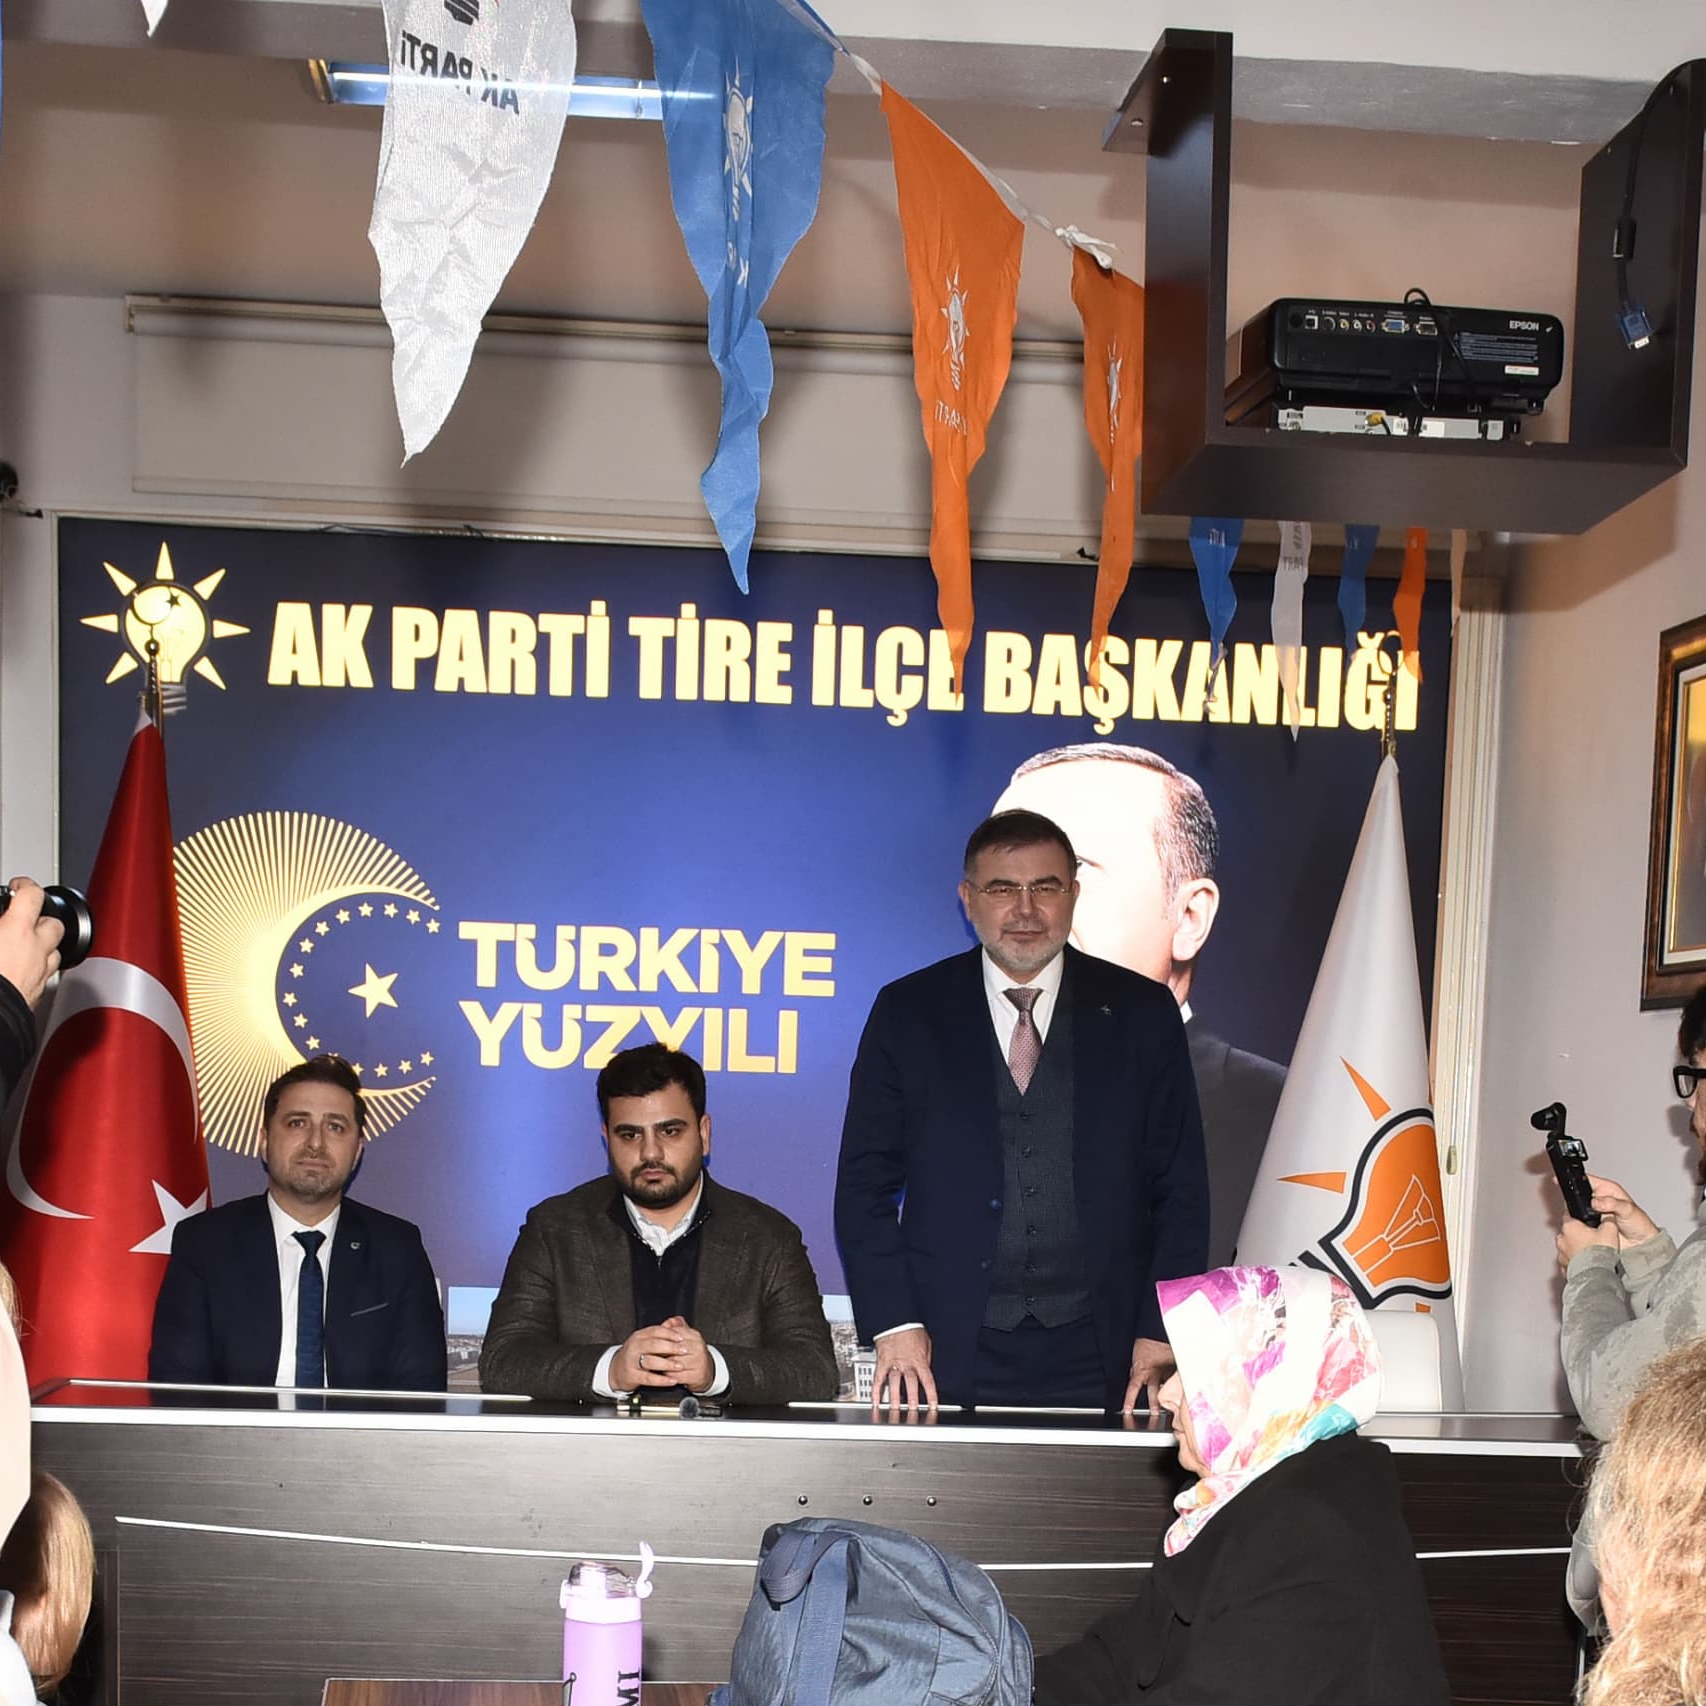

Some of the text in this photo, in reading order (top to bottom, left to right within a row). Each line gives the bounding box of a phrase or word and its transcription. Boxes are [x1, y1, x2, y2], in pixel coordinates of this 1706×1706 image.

[1508, 320, 1540, 332] EPSON
[267, 599, 1420, 736] AK PARTİ TİRE İLÇE BAŞKANLIĞI
